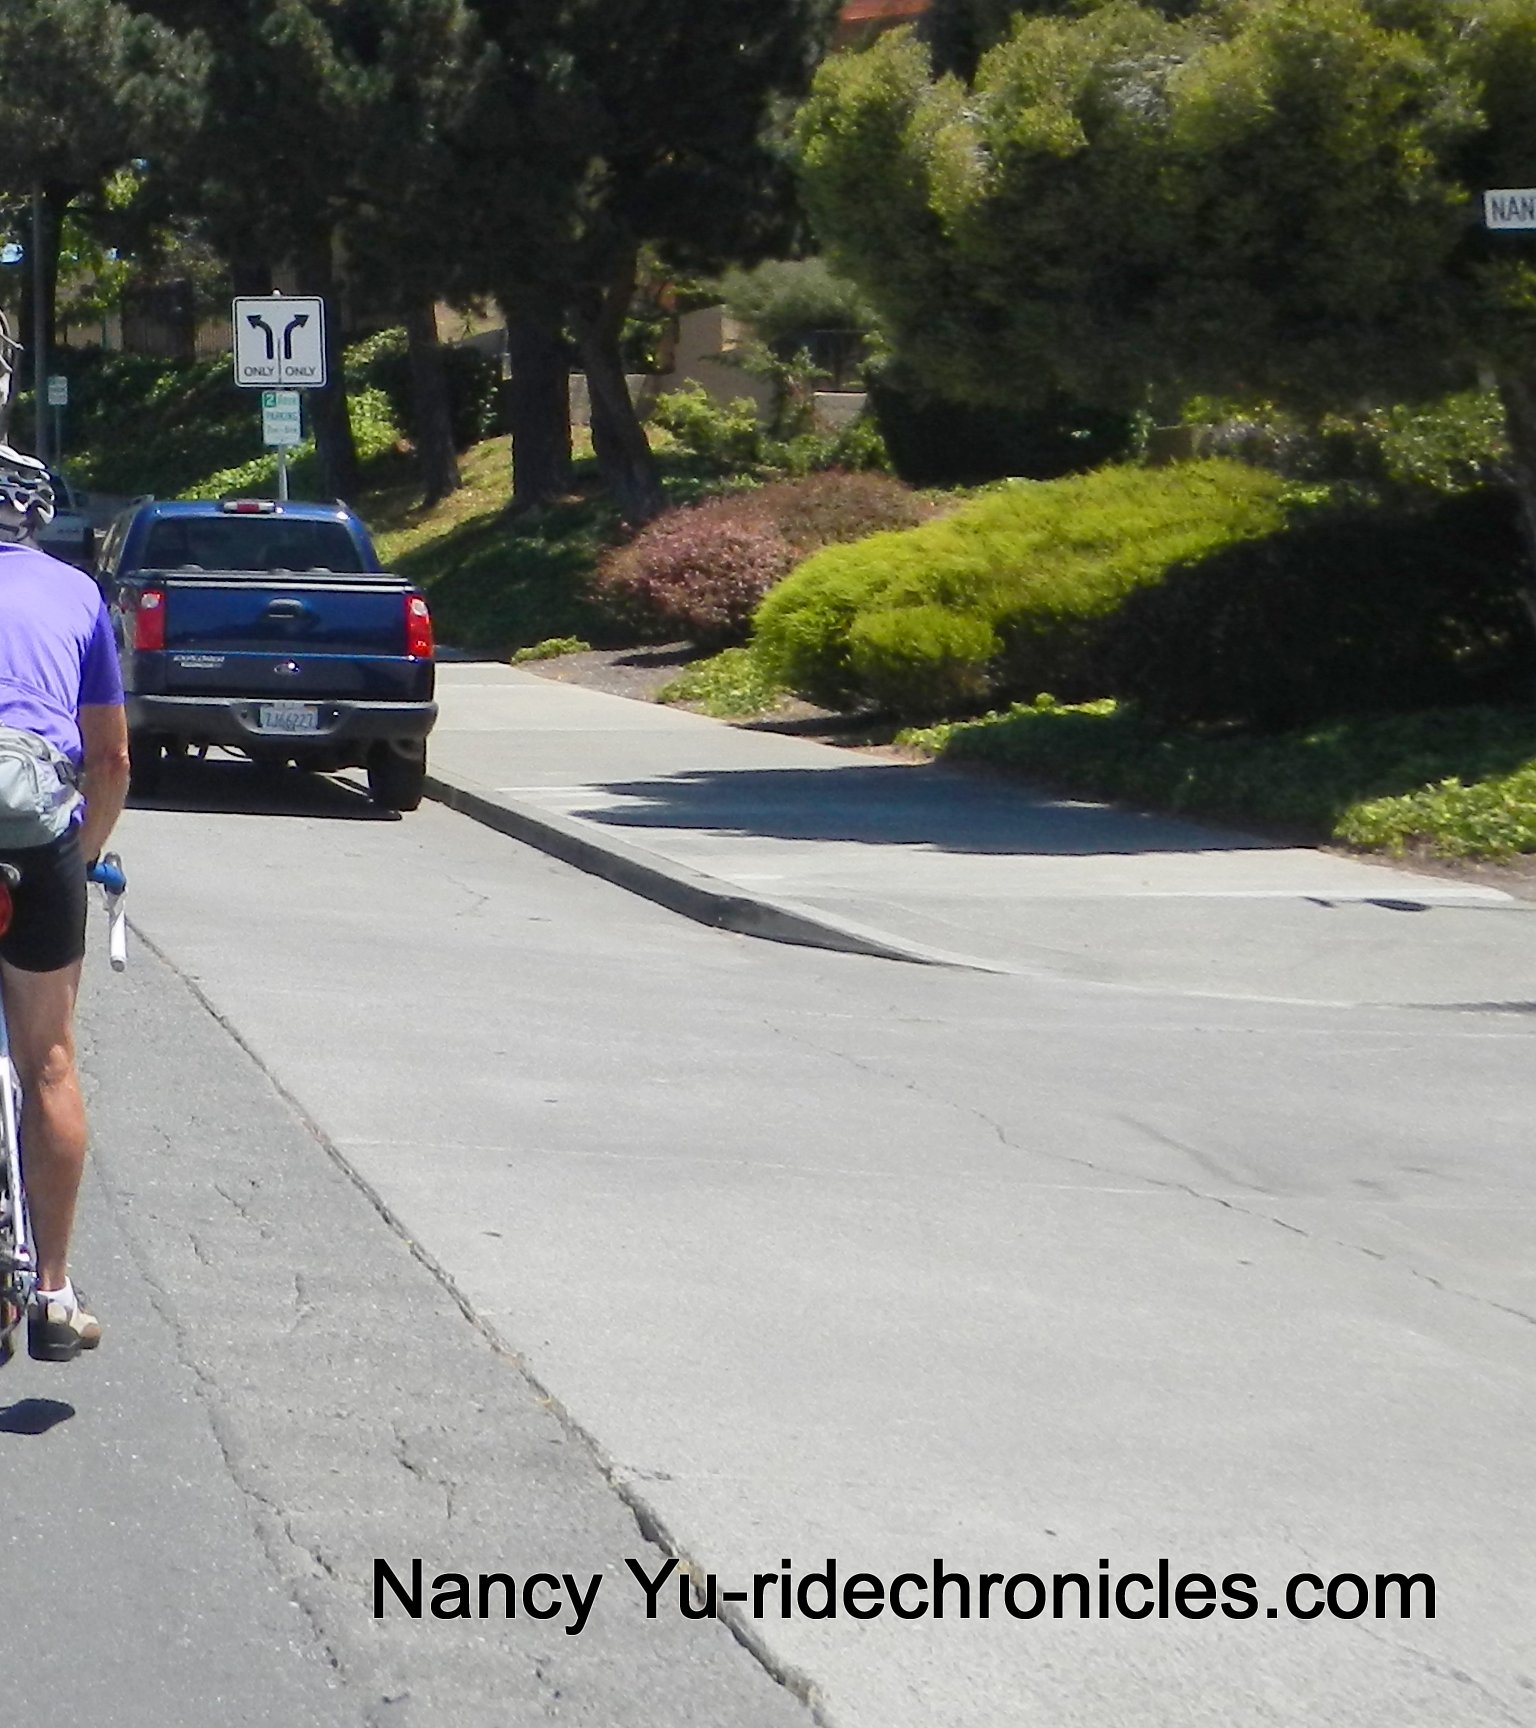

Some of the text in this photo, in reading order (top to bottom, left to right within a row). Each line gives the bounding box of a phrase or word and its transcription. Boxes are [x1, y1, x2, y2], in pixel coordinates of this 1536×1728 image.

[244, 366, 275, 377] ONLY
[285, 366, 316, 377] ONLY
[266, 394, 275, 405] 2
